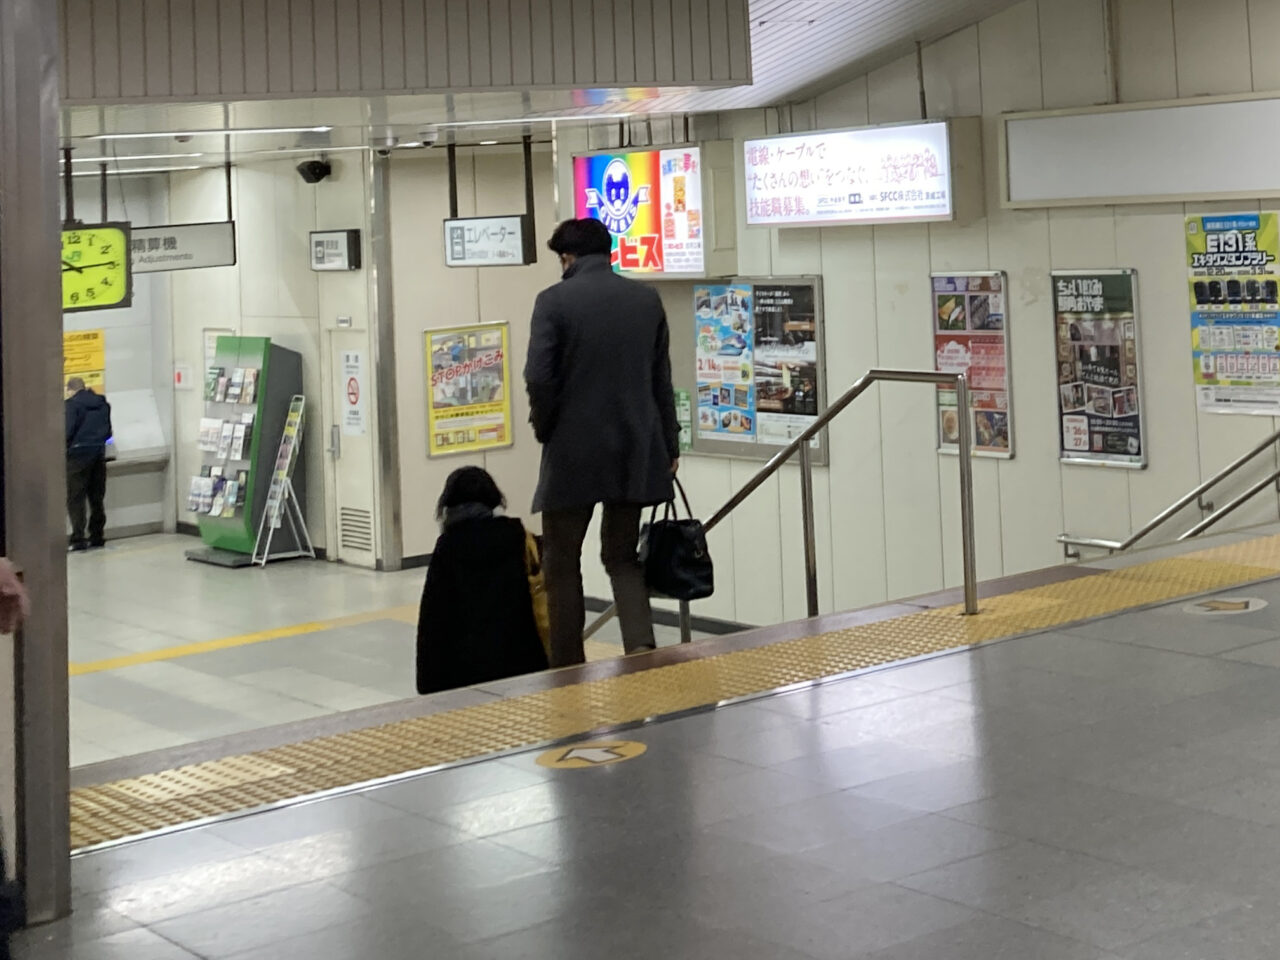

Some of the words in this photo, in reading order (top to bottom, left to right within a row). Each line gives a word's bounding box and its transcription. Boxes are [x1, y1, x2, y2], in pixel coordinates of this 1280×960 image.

[67, 234, 81, 244] 12
[466, 225, 516, 243] エレベーター
[1207, 231, 1256, 252] E131系
[611, 235, 660, 269] ビス
